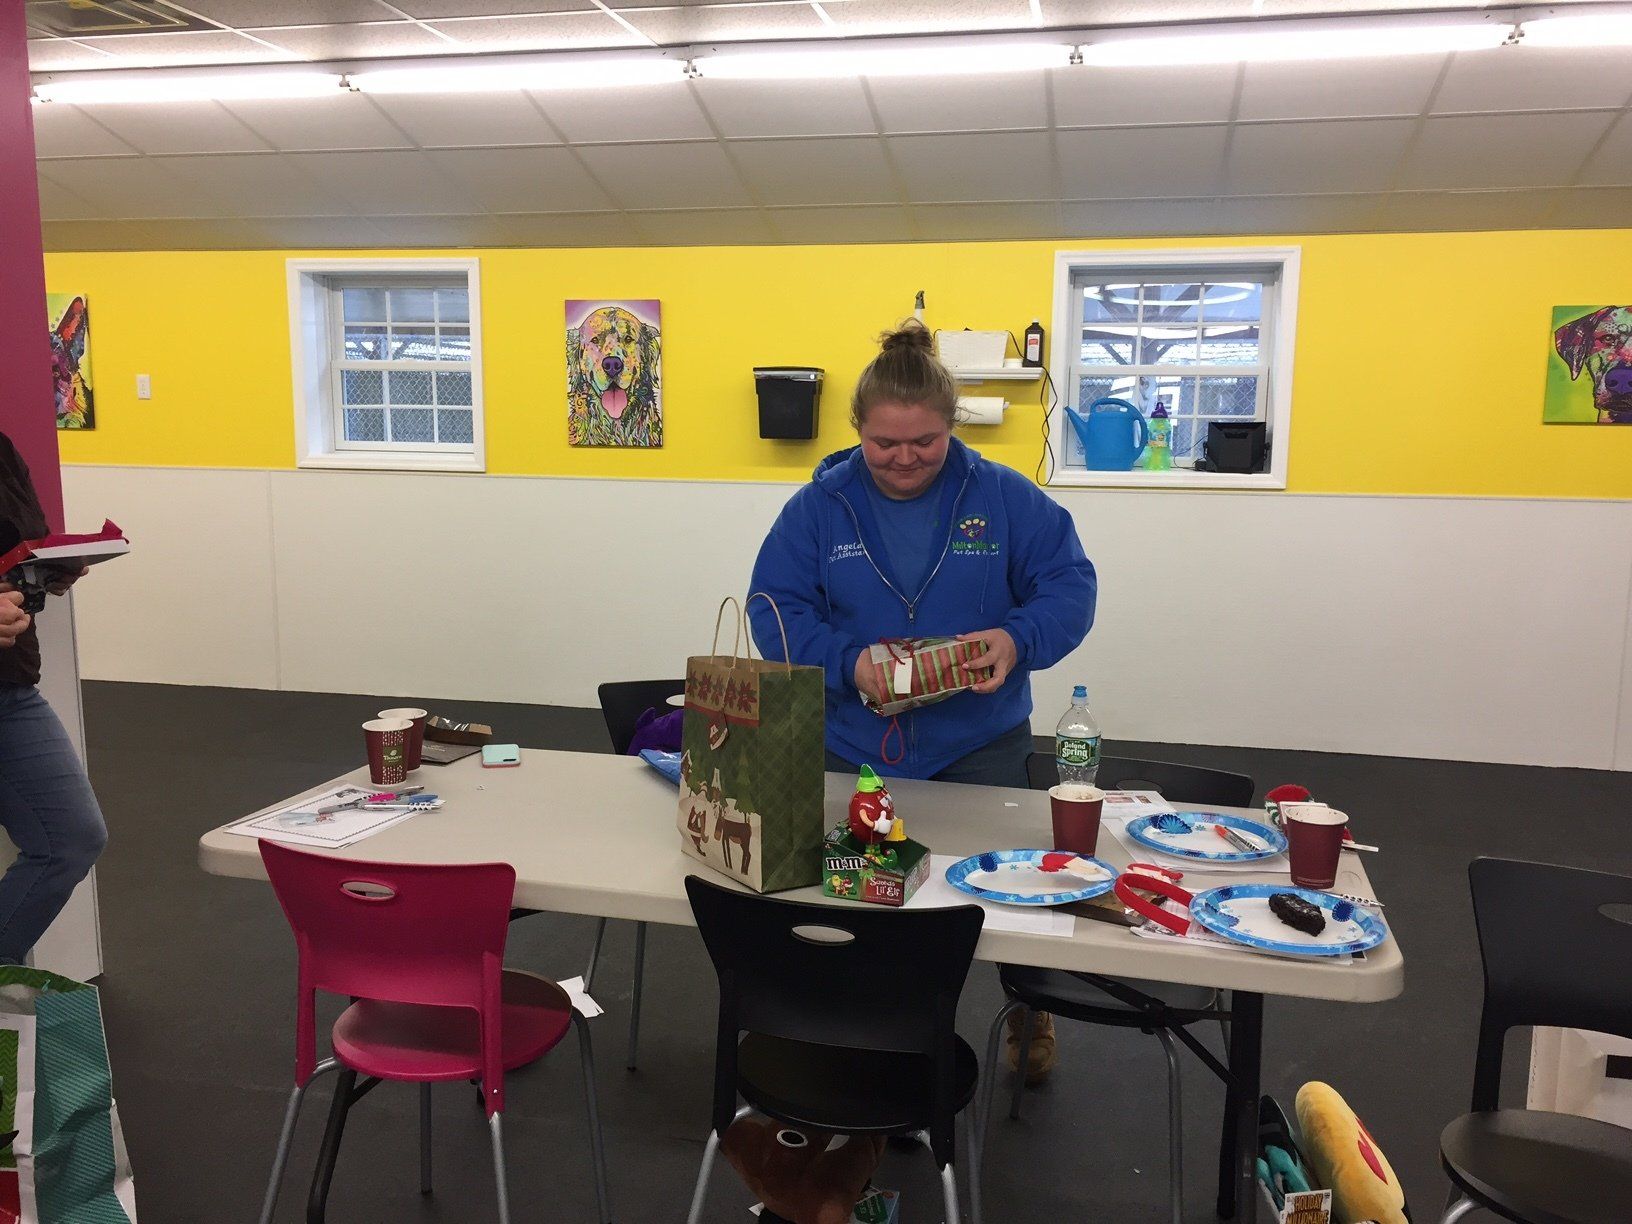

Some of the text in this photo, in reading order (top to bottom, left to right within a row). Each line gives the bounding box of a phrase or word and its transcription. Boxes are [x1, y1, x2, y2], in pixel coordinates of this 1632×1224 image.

[832, 542, 863, 554] Angela
[1064, 741, 1086, 750] Poland
[1061, 748, 1088, 760] Spring
[1294, 1193, 1323, 1211] HOLIDAY
